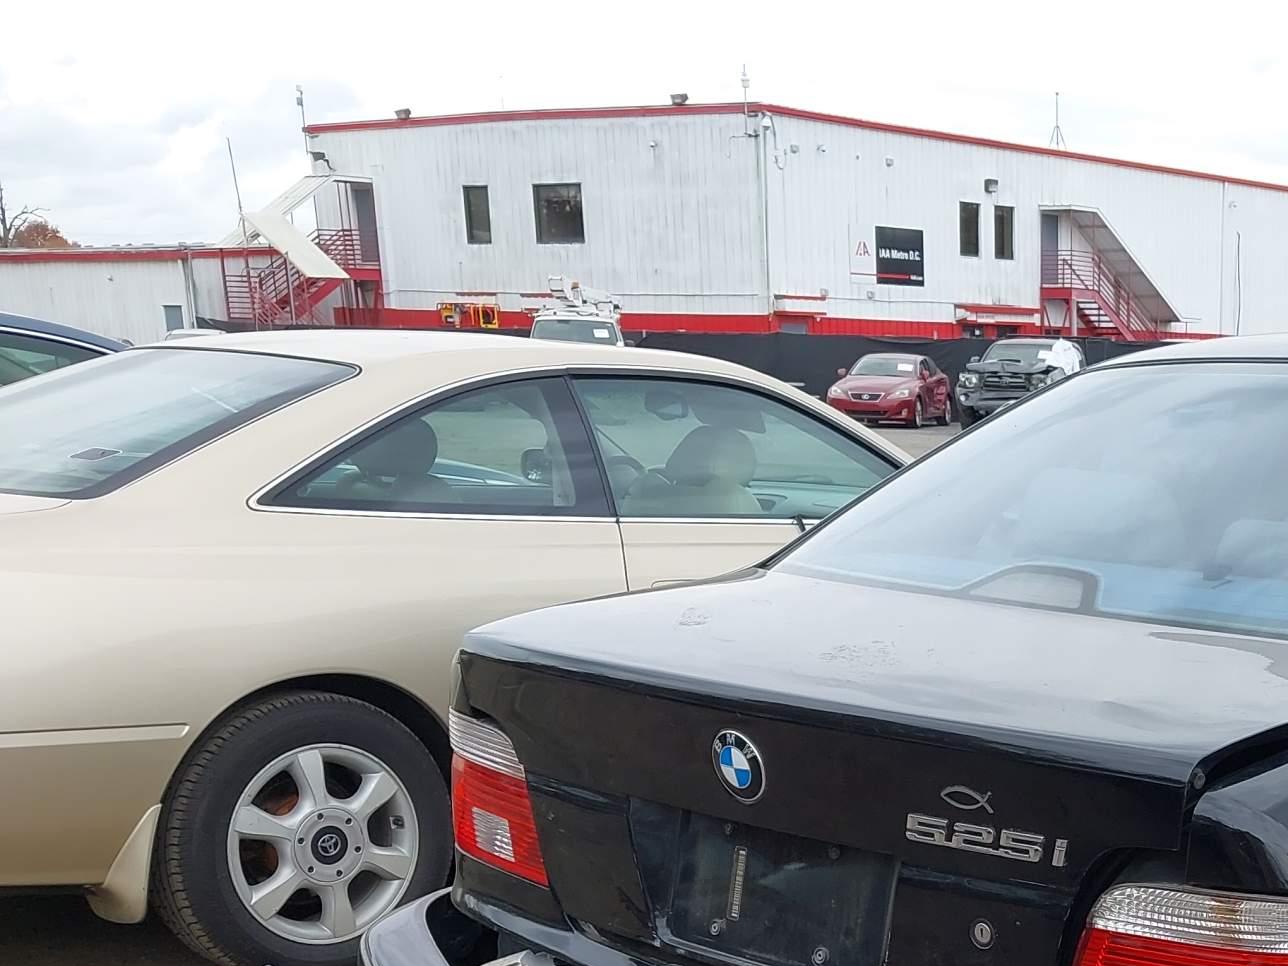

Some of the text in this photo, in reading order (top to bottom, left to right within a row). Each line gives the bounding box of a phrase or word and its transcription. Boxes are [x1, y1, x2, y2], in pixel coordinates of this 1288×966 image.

[879, 247, 921, 261] IAA Metro D.C.
[714, 733, 757, 760] BMW
[905, 813, 1069, 867] 525i
